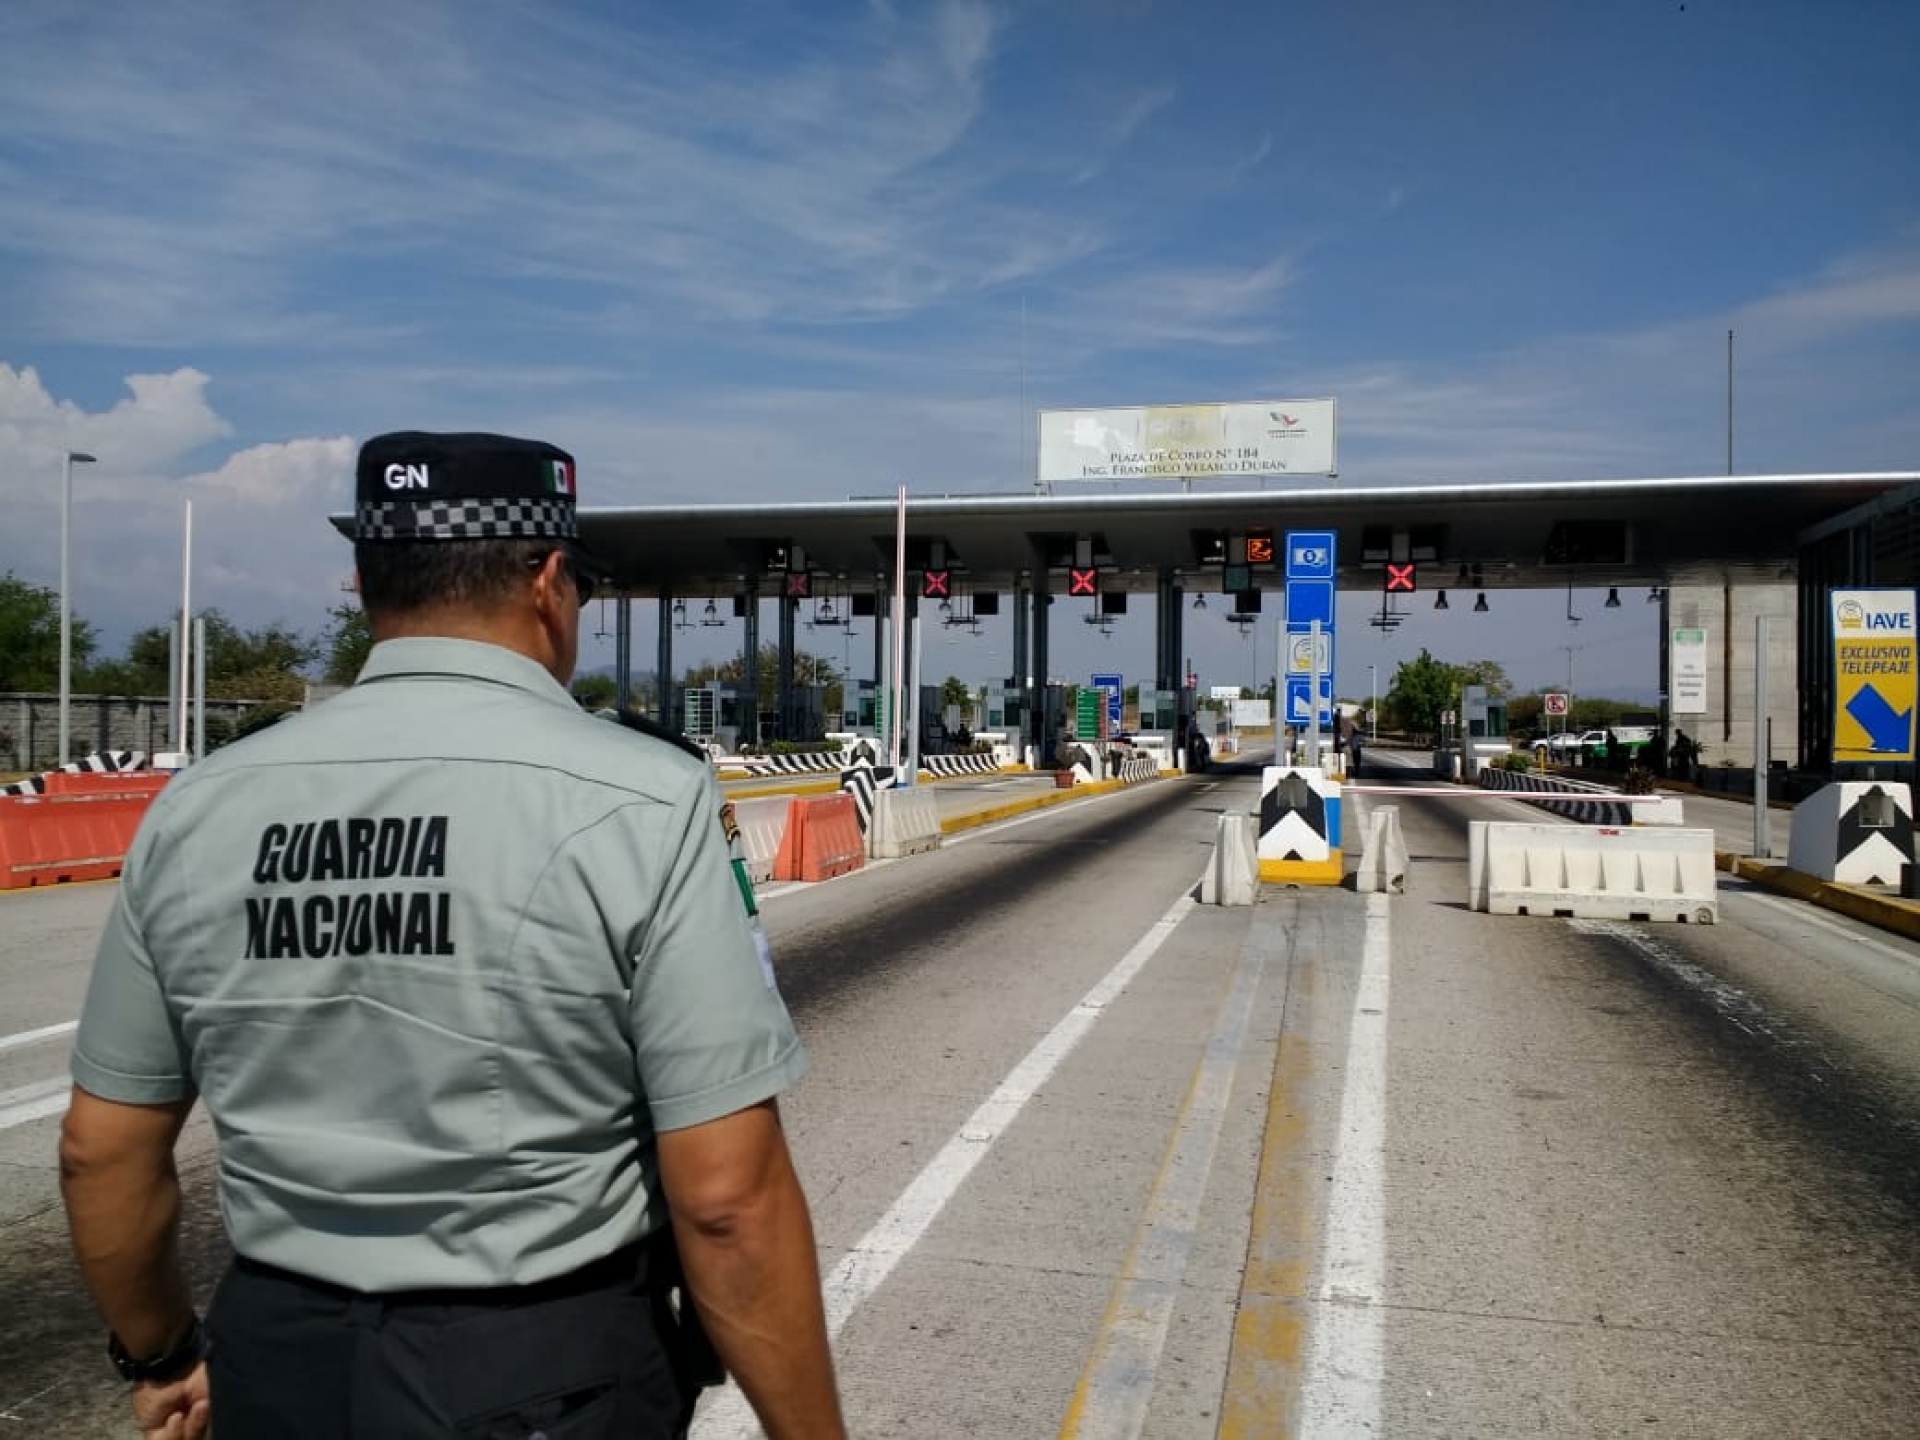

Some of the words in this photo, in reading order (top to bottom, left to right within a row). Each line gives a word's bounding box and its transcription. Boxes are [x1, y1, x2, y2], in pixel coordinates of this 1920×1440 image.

[384, 463, 429, 489] GN
[1112, 464, 1181, 475] FRANCISCO
[1184, 460, 1238, 474] VELASCO
[1866, 612, 1911, 629] IAVE
[1841, 646, 1911, 659] EXCLUSIVO
[1842, 660, 1911, 675] TELEPEAJE
[253, 816, 449, 884] GUARDIA
[244, 892, 455, 959] NACIONAL
